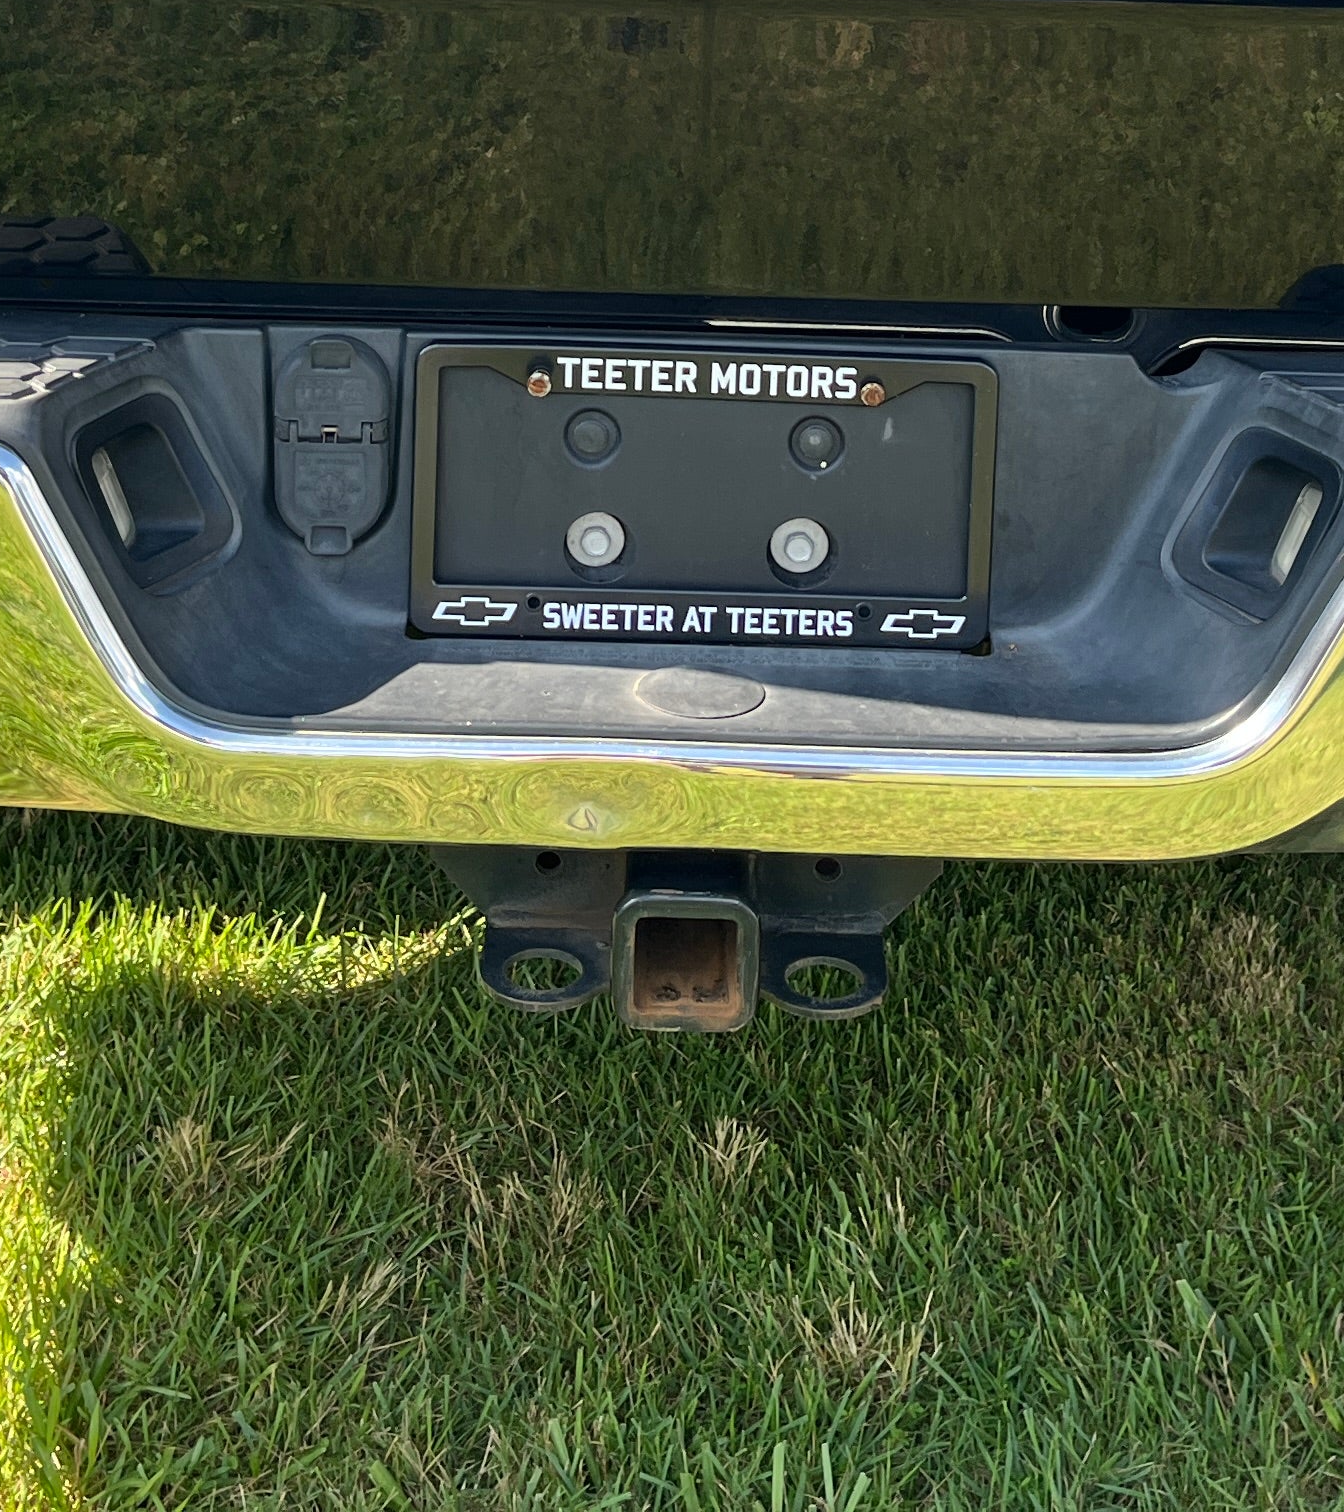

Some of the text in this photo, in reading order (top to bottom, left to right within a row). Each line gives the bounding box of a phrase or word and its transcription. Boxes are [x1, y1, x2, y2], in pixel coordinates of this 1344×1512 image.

[556, 356, 858, 399] TEETER MOTORS
[543, 602, 853, 637] SWEETER AT TEETERS
